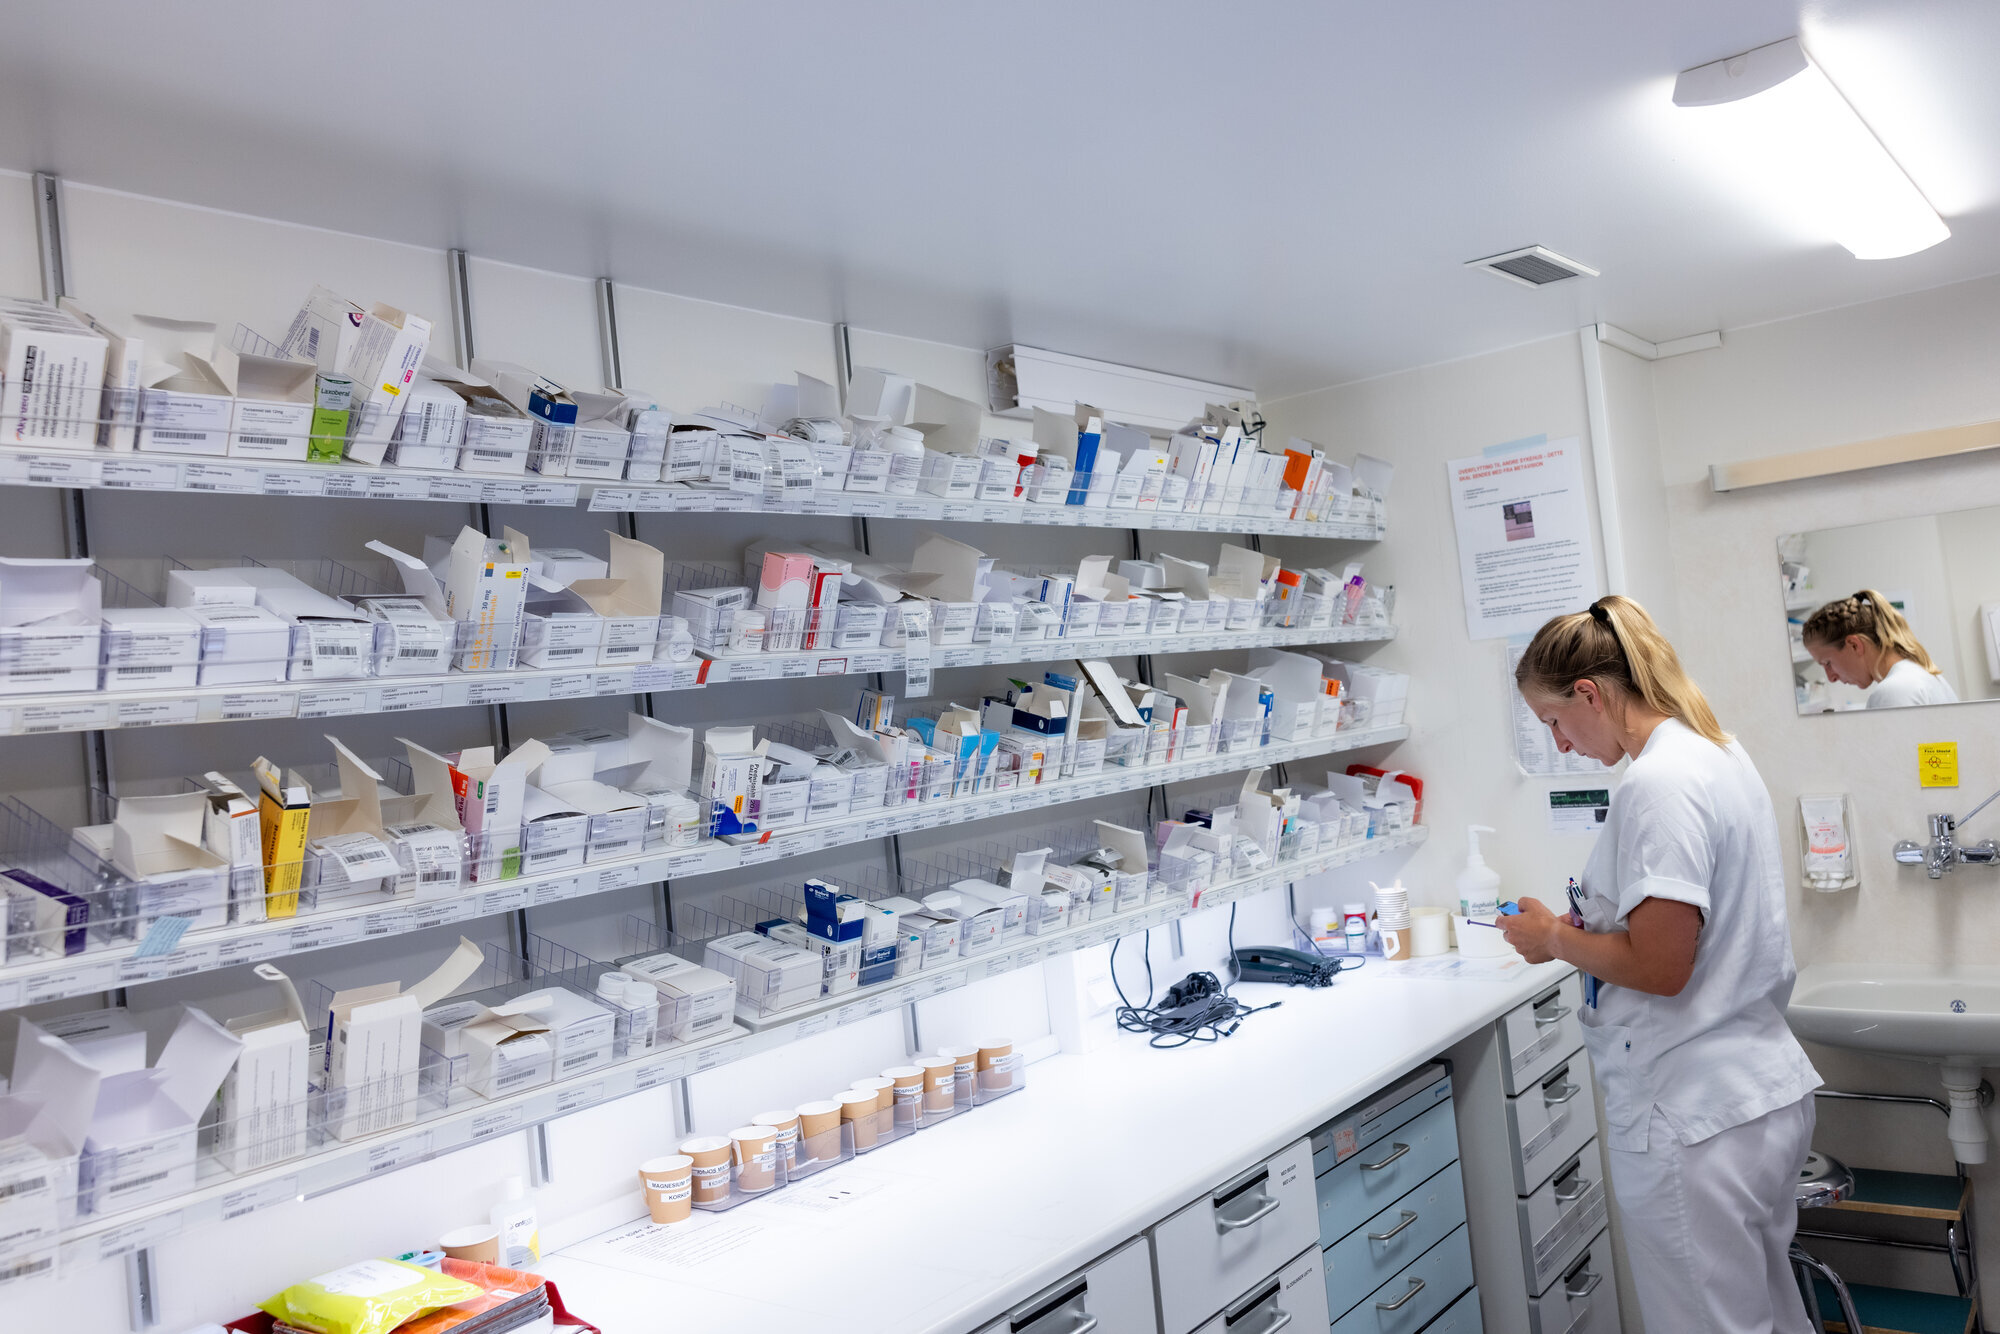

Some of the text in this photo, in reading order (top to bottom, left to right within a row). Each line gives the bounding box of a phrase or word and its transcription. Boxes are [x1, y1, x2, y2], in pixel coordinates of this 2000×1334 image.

[320, 388, 350, 397] Laxoberal
[1458, 464, 1492, 474] OVERFLYTTING
[1520, 454, 1542, 463] SYKEHUS
[1547, 450, 1563, 458] DETTE
[1514, 462, 1544, 471] METAVISION
[484, 589, 492, 600] mg
[482, 602, 488, 610] 30
[468, 639, 482, 669] Lasix
[752, 763, 760, 798] Prednisolon
[652, 1180, 686, 1189] MAGNESIUM
